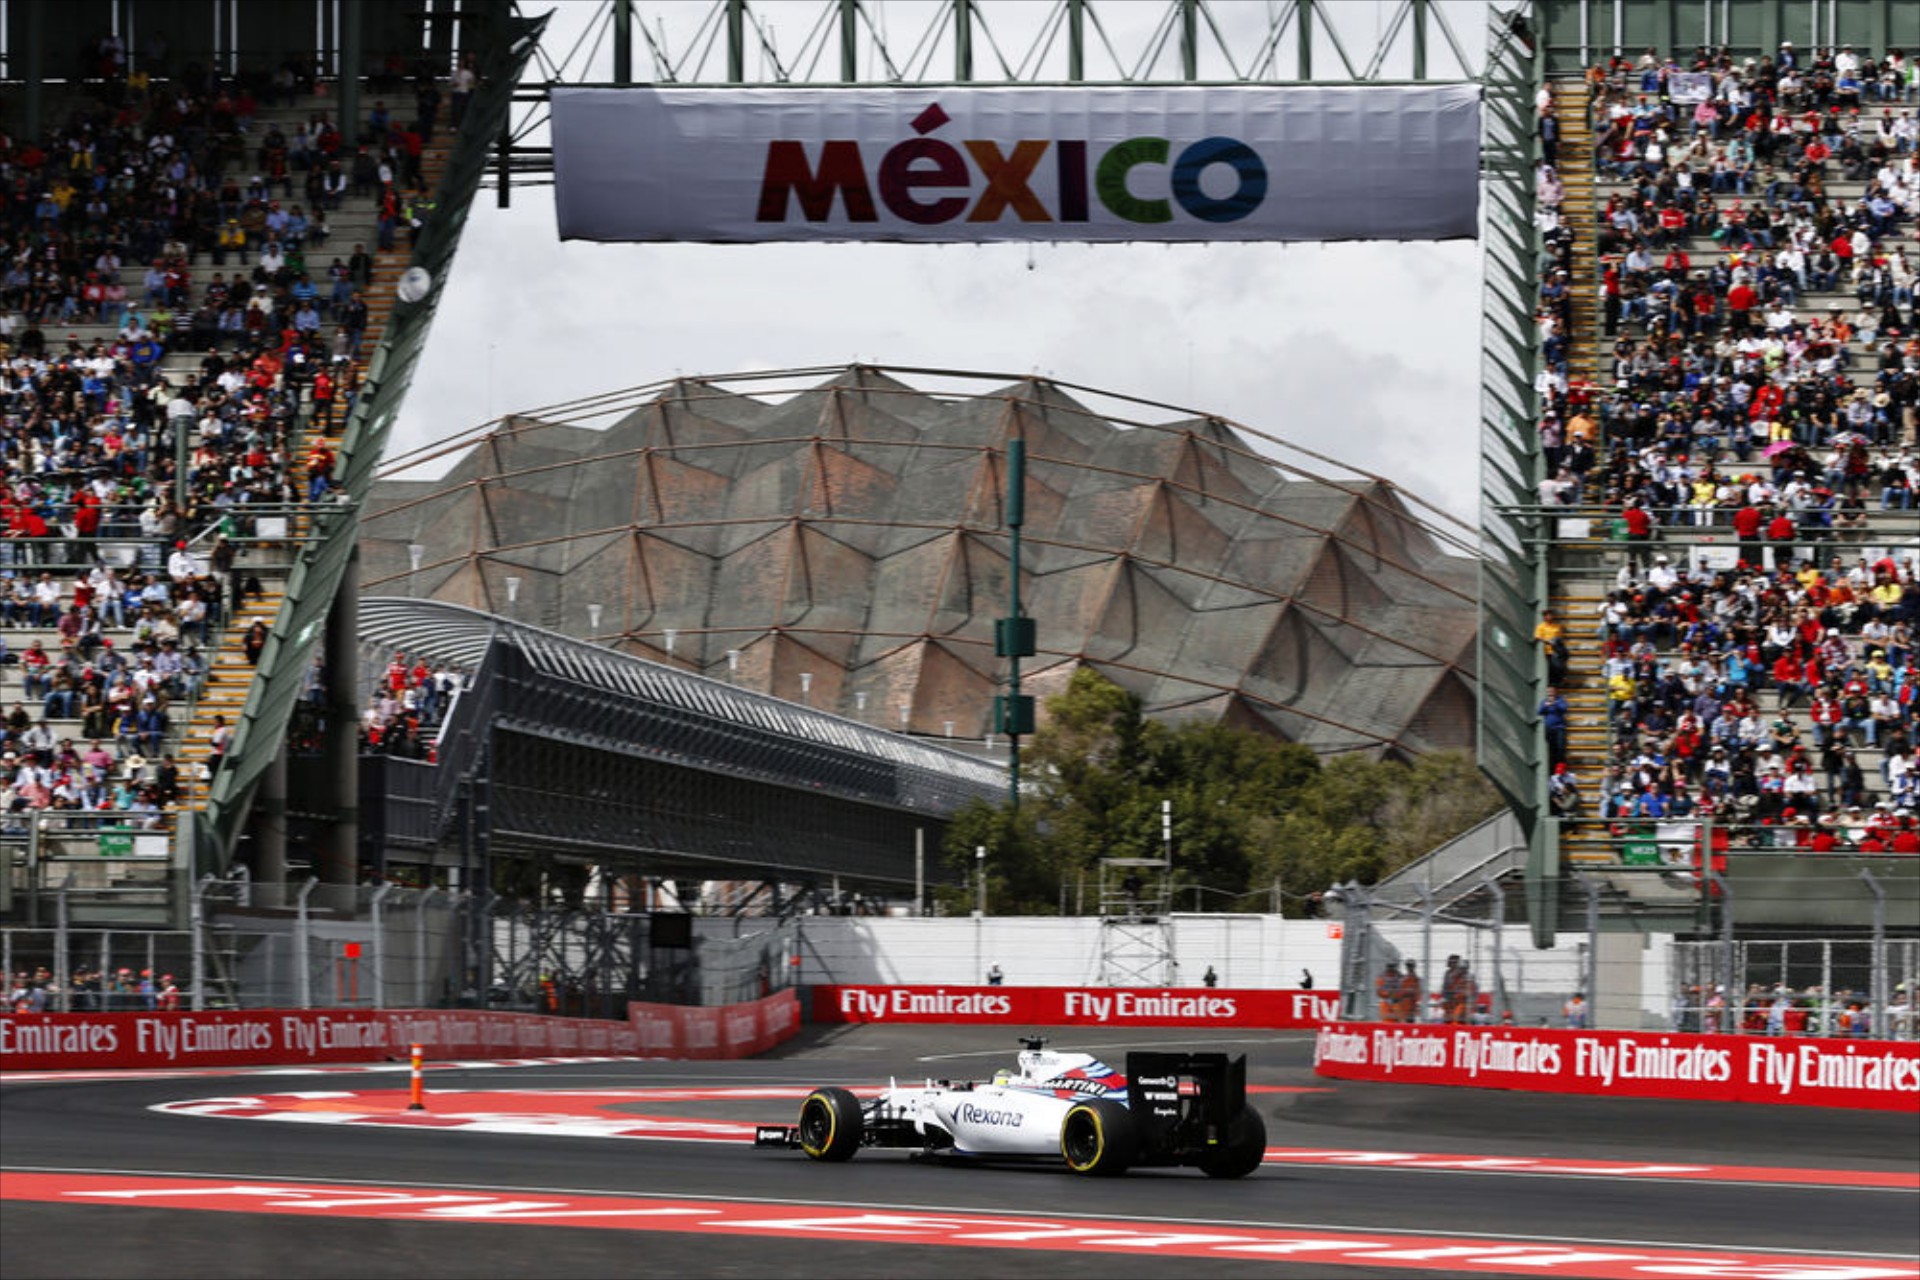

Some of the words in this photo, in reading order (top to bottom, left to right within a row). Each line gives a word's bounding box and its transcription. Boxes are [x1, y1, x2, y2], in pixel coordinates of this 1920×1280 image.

[841, 989, 887, 1018] Fly
[891, 989, 1010, 1014] Emirates
[1064, 992, 1112, 1022] Fly
[1115, 992, 1237, 1018] Emirates
[1293, 994, 1339, 1021] Fly
[0, 1016, 118, 1054] Emirates
[135, 1018, 178, 1060] Fly
[180, 1016, 272, 1052] Emirates
[283, 1016, 316, 1056] Fly
[1453, 1031, 1480, 1077] Fly
[1480, 1031, 1561, 1074] Emirates
[1575, 1037, 1615, 1086] Fly
[1618, 1037, 1731, 1082] Emirates
[1748, 1043, 1795, 1095] Fly
[1798, 1044, 1920, 1092] Emirates
[963, 1102, 1023, 1127] Rexona
